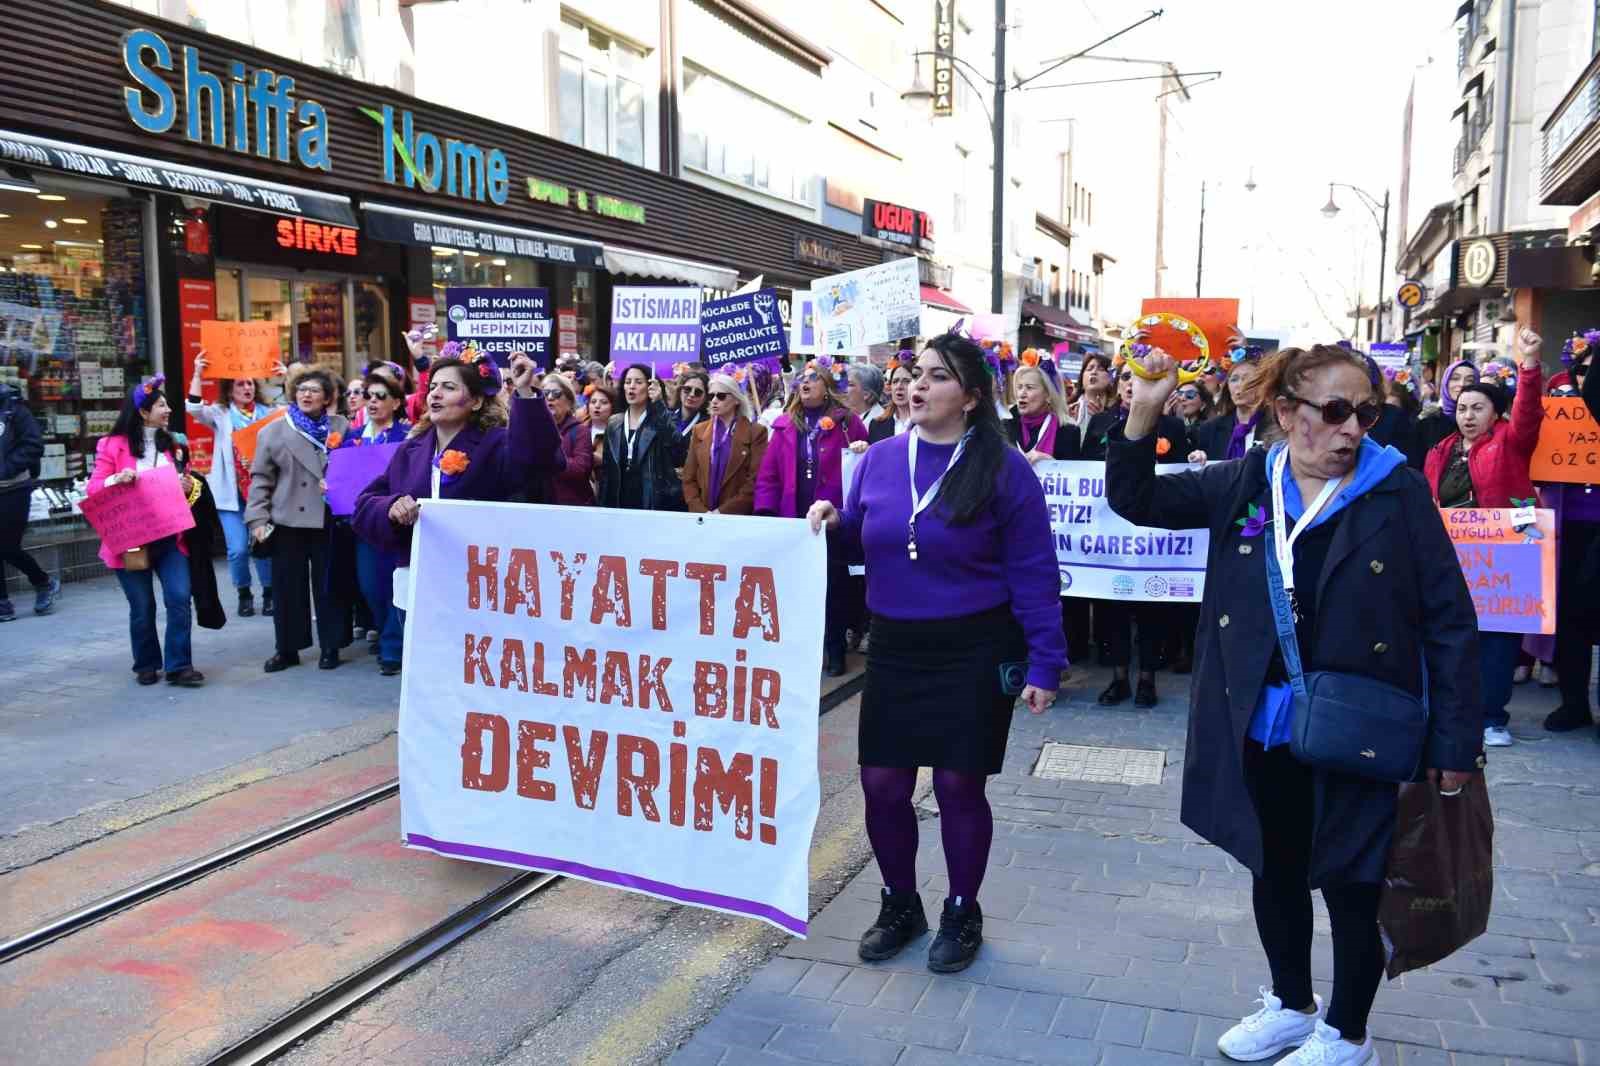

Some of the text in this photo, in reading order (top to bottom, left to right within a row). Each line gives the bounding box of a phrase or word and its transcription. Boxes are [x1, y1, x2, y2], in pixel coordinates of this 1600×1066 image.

[123, 28, 332, 172] Shiffa
[275, 215, 358, 256] SİRKE
[469, 296, 544, 308] BİR KADININ
[616, 293, 697, 319] İSTİSMARI
[470, 320, 544, 335] HEPİMİZİN
[702, 315, 753, 334] KARARLI
[705, 325, 779, 349] ÖZGÜRLÜKTE
[614, 331, 696, 353] AKLAMA!
[708, 339, 781, 365] ISRARCIYIZ!
[1040, 472, 1072, 497] ĞİL
[1080, 531, 1193, 556] ÇARESİYİZ!
[1450, 527, 1505, 540] UYGULA
[466, 544, 781, 643] HAYATTA
[463, 632, 782, 729] KALMAK BİR
[460, 711, 779, 846] DEVRİM!
